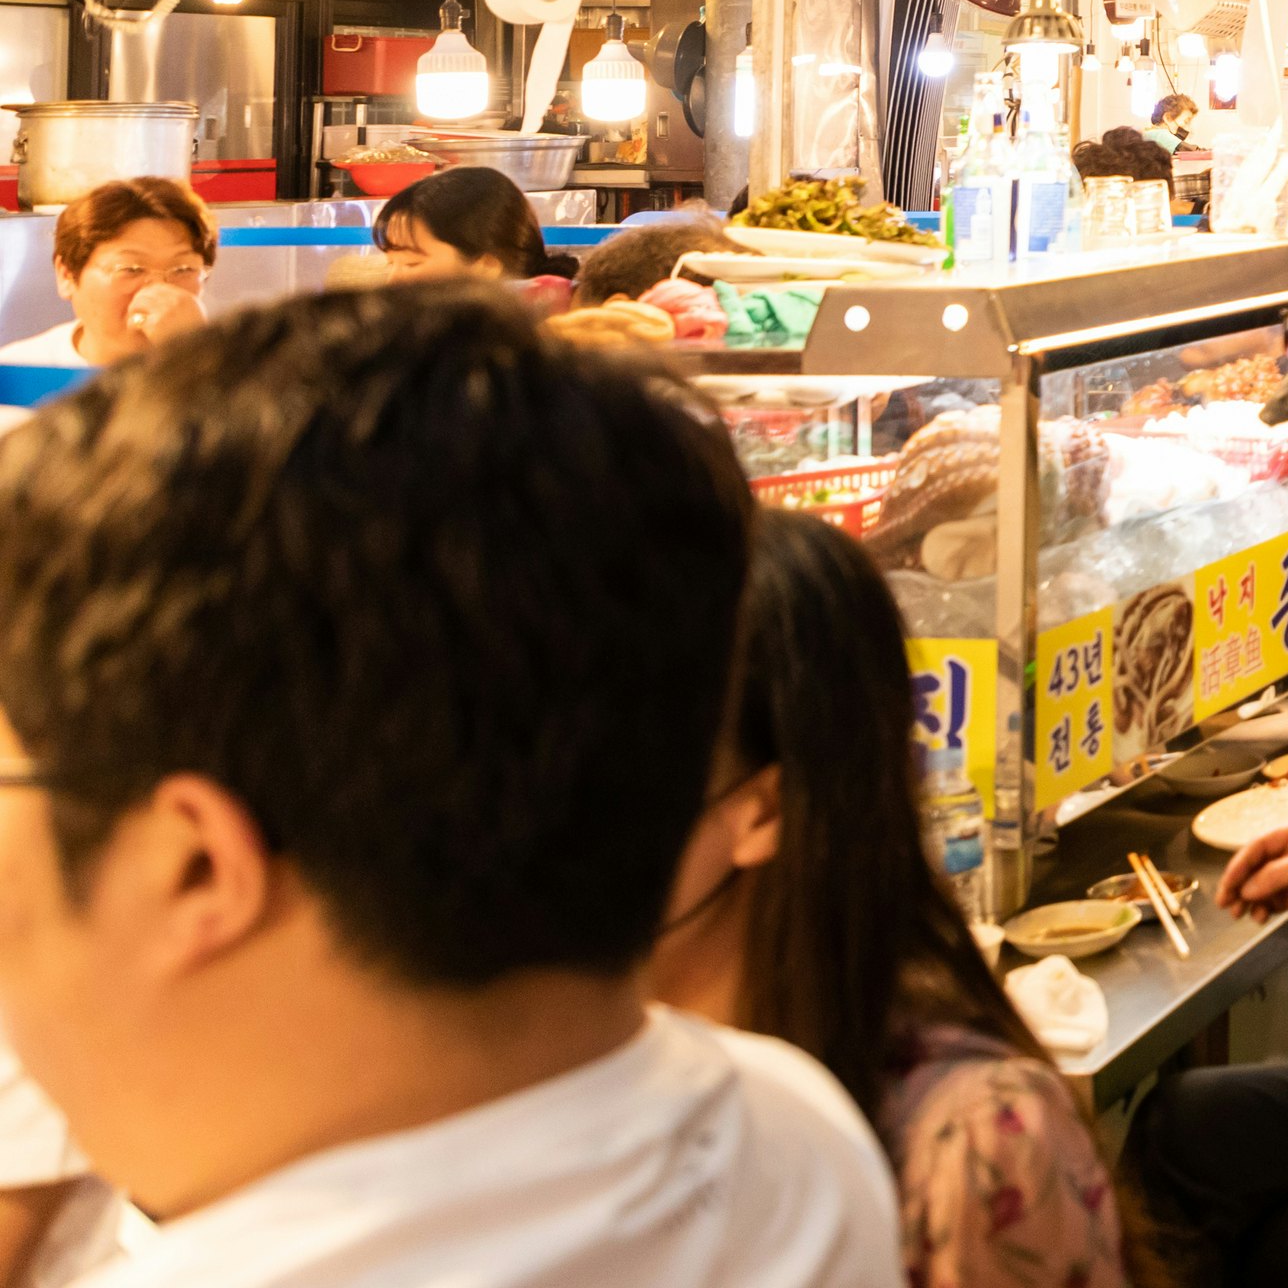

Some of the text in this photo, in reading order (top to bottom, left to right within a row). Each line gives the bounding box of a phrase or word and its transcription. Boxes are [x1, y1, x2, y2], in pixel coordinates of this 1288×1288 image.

[1209, 562, 1255, 629] 낙지
[1049, 628, 1103, 696] 43년
[1049, 701, 1104, 773] 전통
